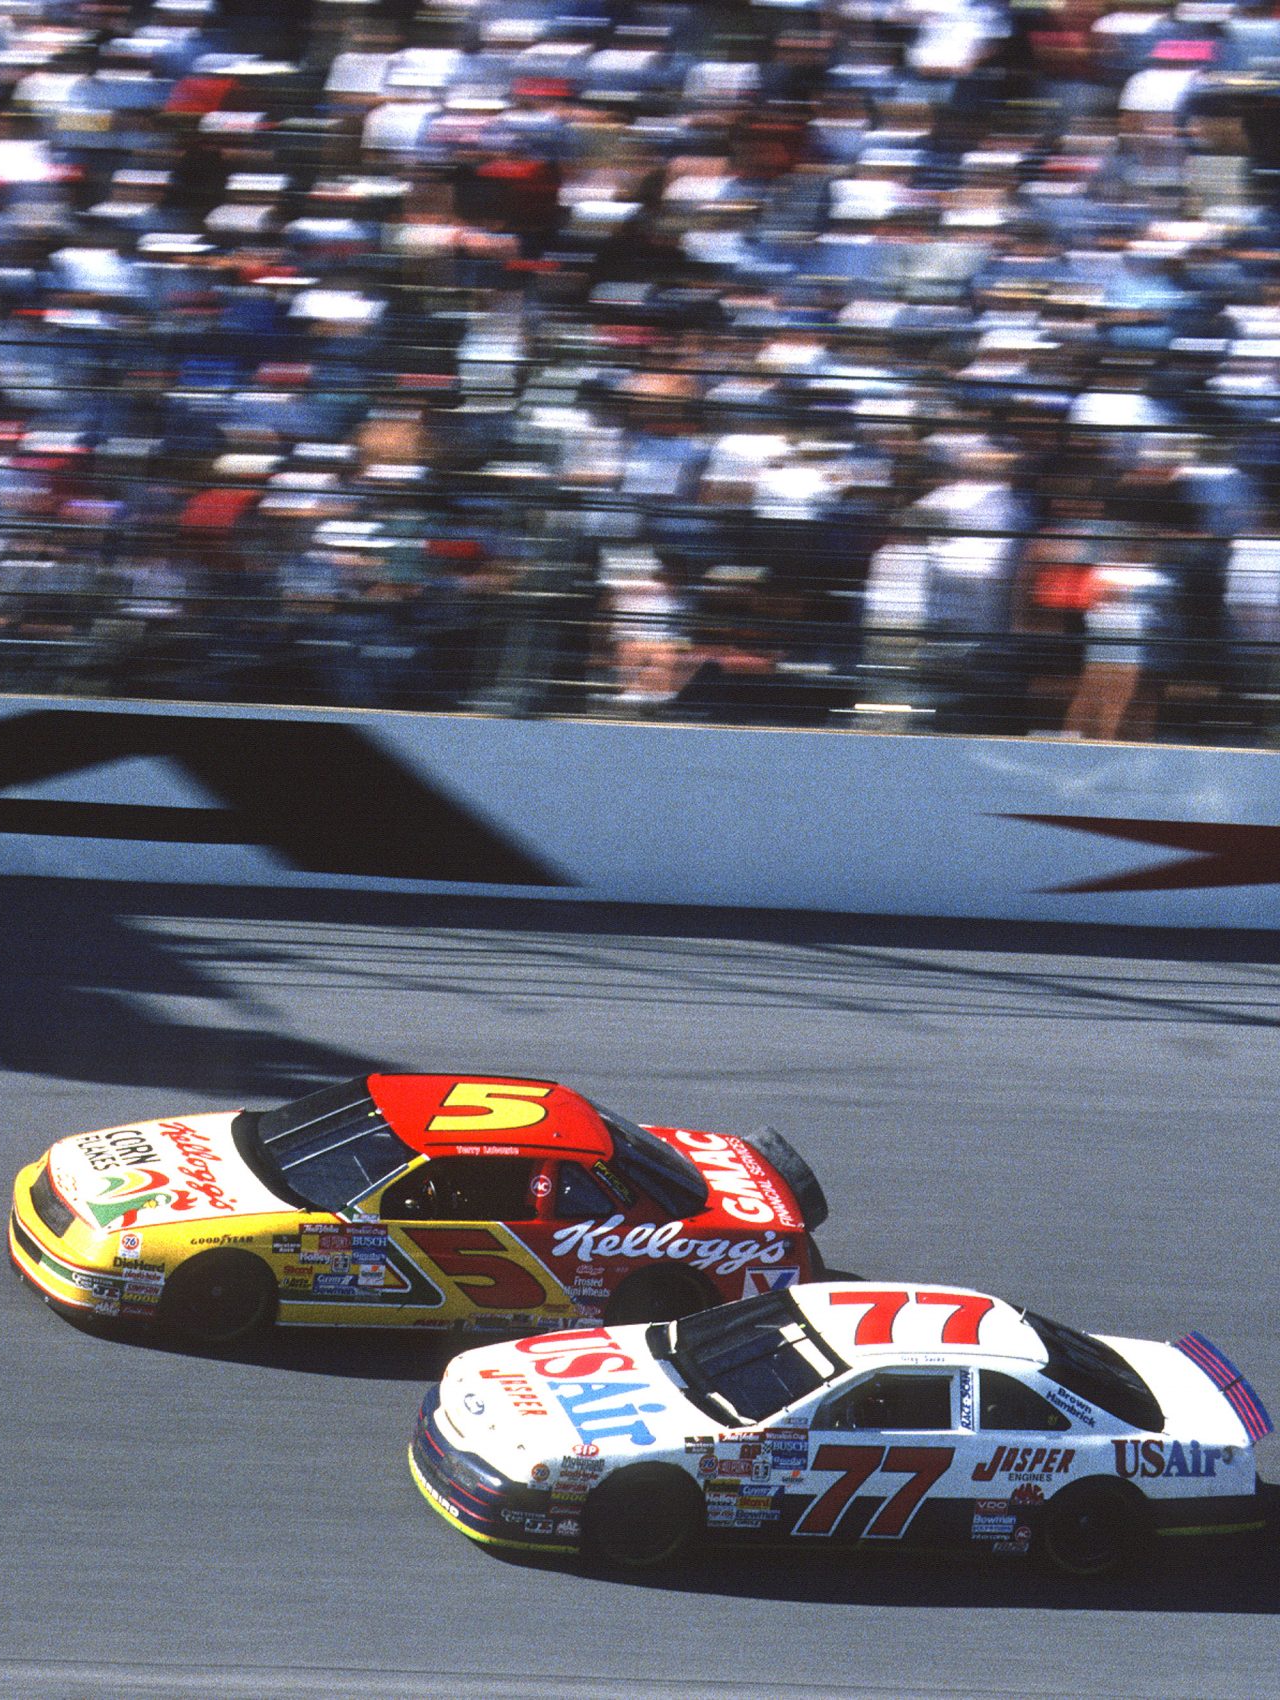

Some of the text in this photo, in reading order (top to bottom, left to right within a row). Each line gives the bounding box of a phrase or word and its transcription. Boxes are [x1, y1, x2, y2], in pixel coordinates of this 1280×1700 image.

[426, 1082, 552, 1132] 5
[78, 1134, 120, 1171] FLAKES
[105, 1130, 161, 1166] CORN
[158, 1122, 237, 1211] Kellogg's
[675, 1130, 774, 1223] GMAC
[190, 1234, 254, 1245] GOODYEAR
[352, 1236, 387, 1246] BUSCH
[552, 1213, 788, 1275] Kellogg's
[113, 1256, 165, 1272] DieHard
[402, 1227, 548, 1311] 5
[573, 1276, 603, 1288] Frosted
[829, 1291, 994, 1346] 77
[480, 1369, 548, 1417] JASPER
[1046, 1391, 1096, 1428] Hambrick
[1057, 1387, 1093, 1414] Brown
[773, 1441, 808, 1451] BUSCH
[971, 1445, 1076, 1481] JASPER
[1111, 1439, 1222, 1480] USAir
[790, 1444, 955, 1539] 77
[1008, 1473, 1053, 1482] ENGINES
[974, 1514, 1017, 1526] Bowman
[977, 1501, 1007, 1509] VDO
